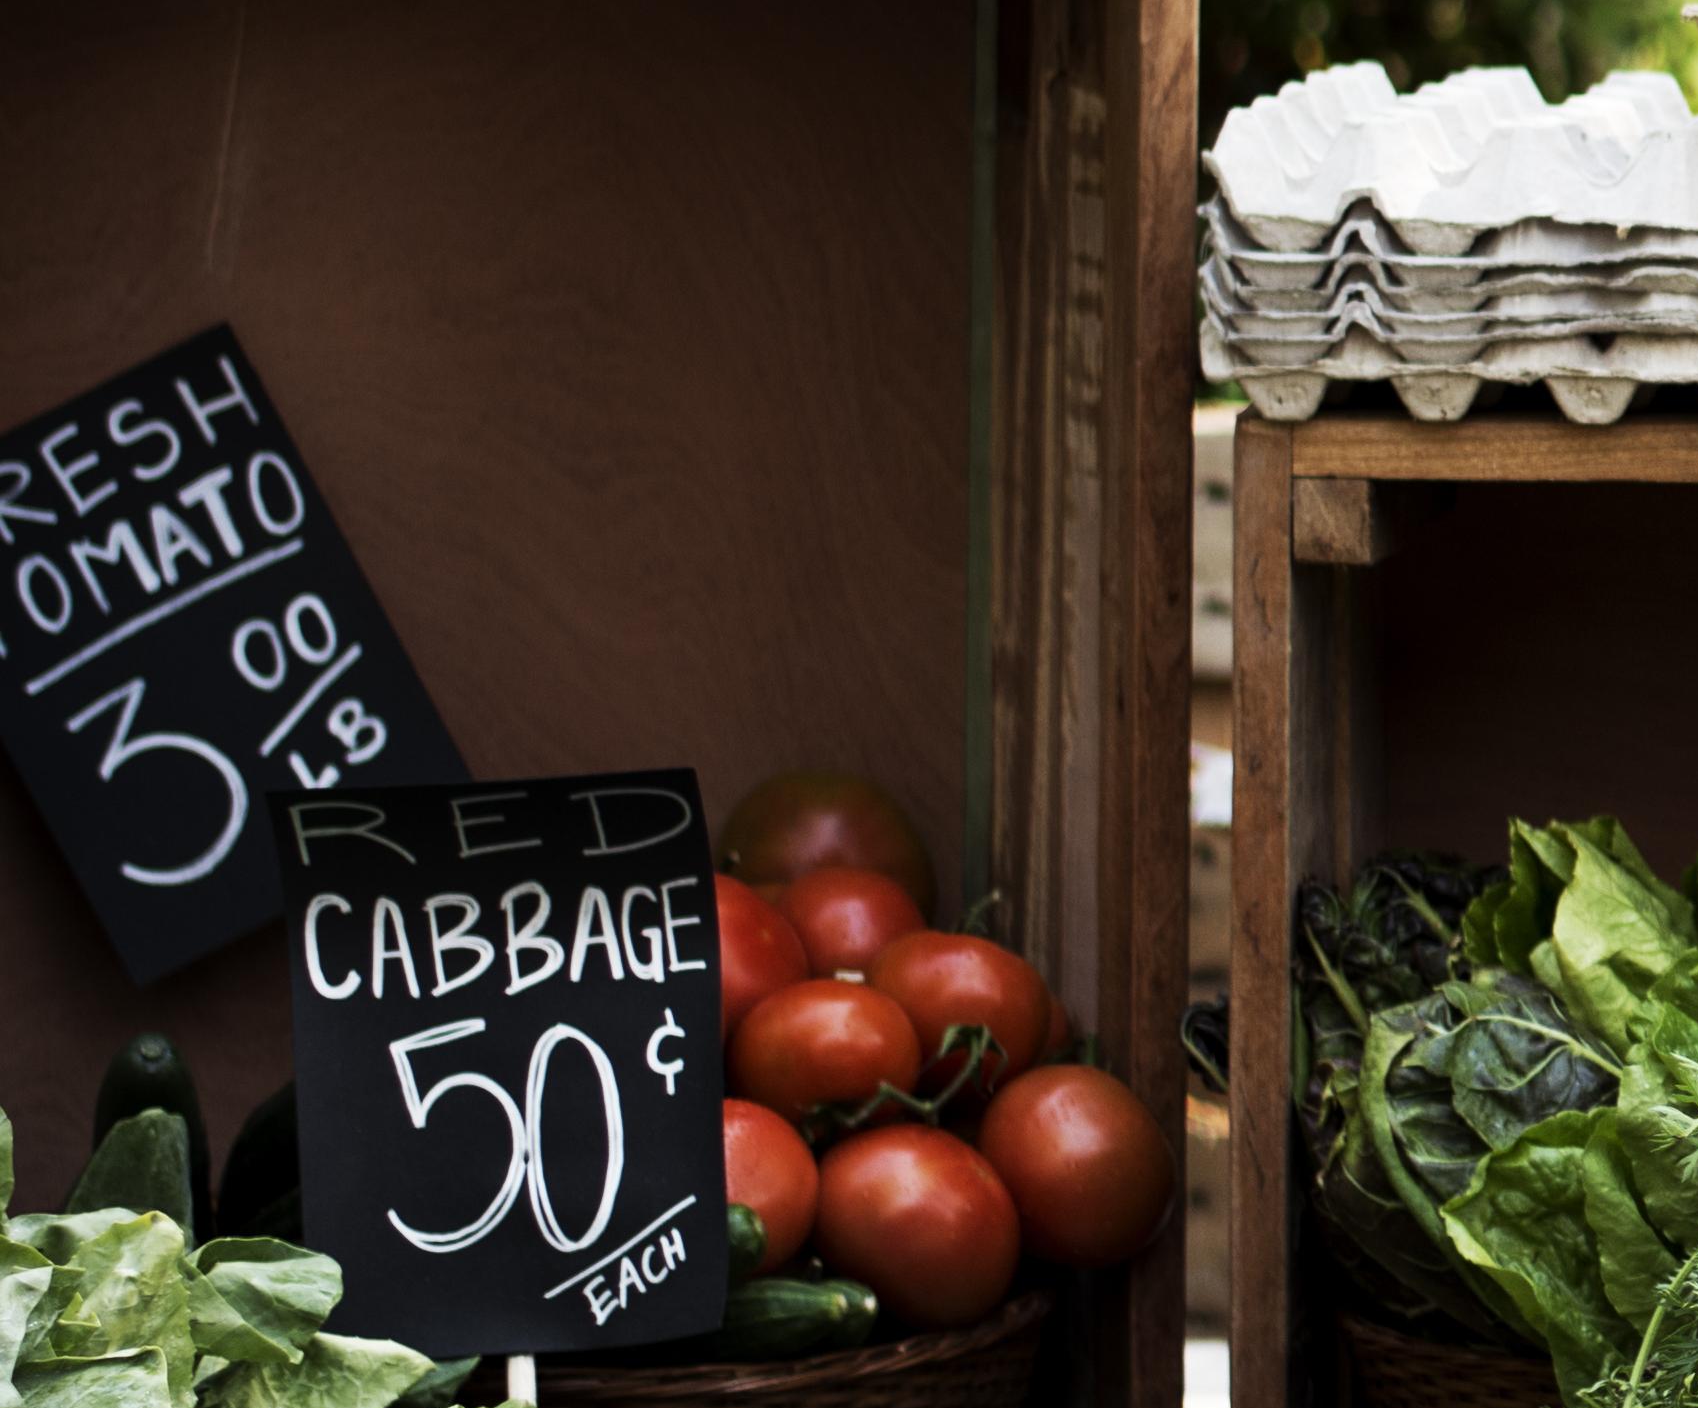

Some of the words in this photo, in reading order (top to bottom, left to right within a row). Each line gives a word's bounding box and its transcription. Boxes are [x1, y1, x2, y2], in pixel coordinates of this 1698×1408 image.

[0, 355, 260, 543] RESH
[0, 451, 305, 659] OMATO
[66, 677, 248, 885] 3
[231, 594, 337, 690] 00
[287, 698, 388, 790] LB
[289, 789, 692, 866] RED
[304, 877, 707, 1000] CABBAGE
[387, 1017, 625, 1254] 50
[583, 1227, 687, 1326] EACH
